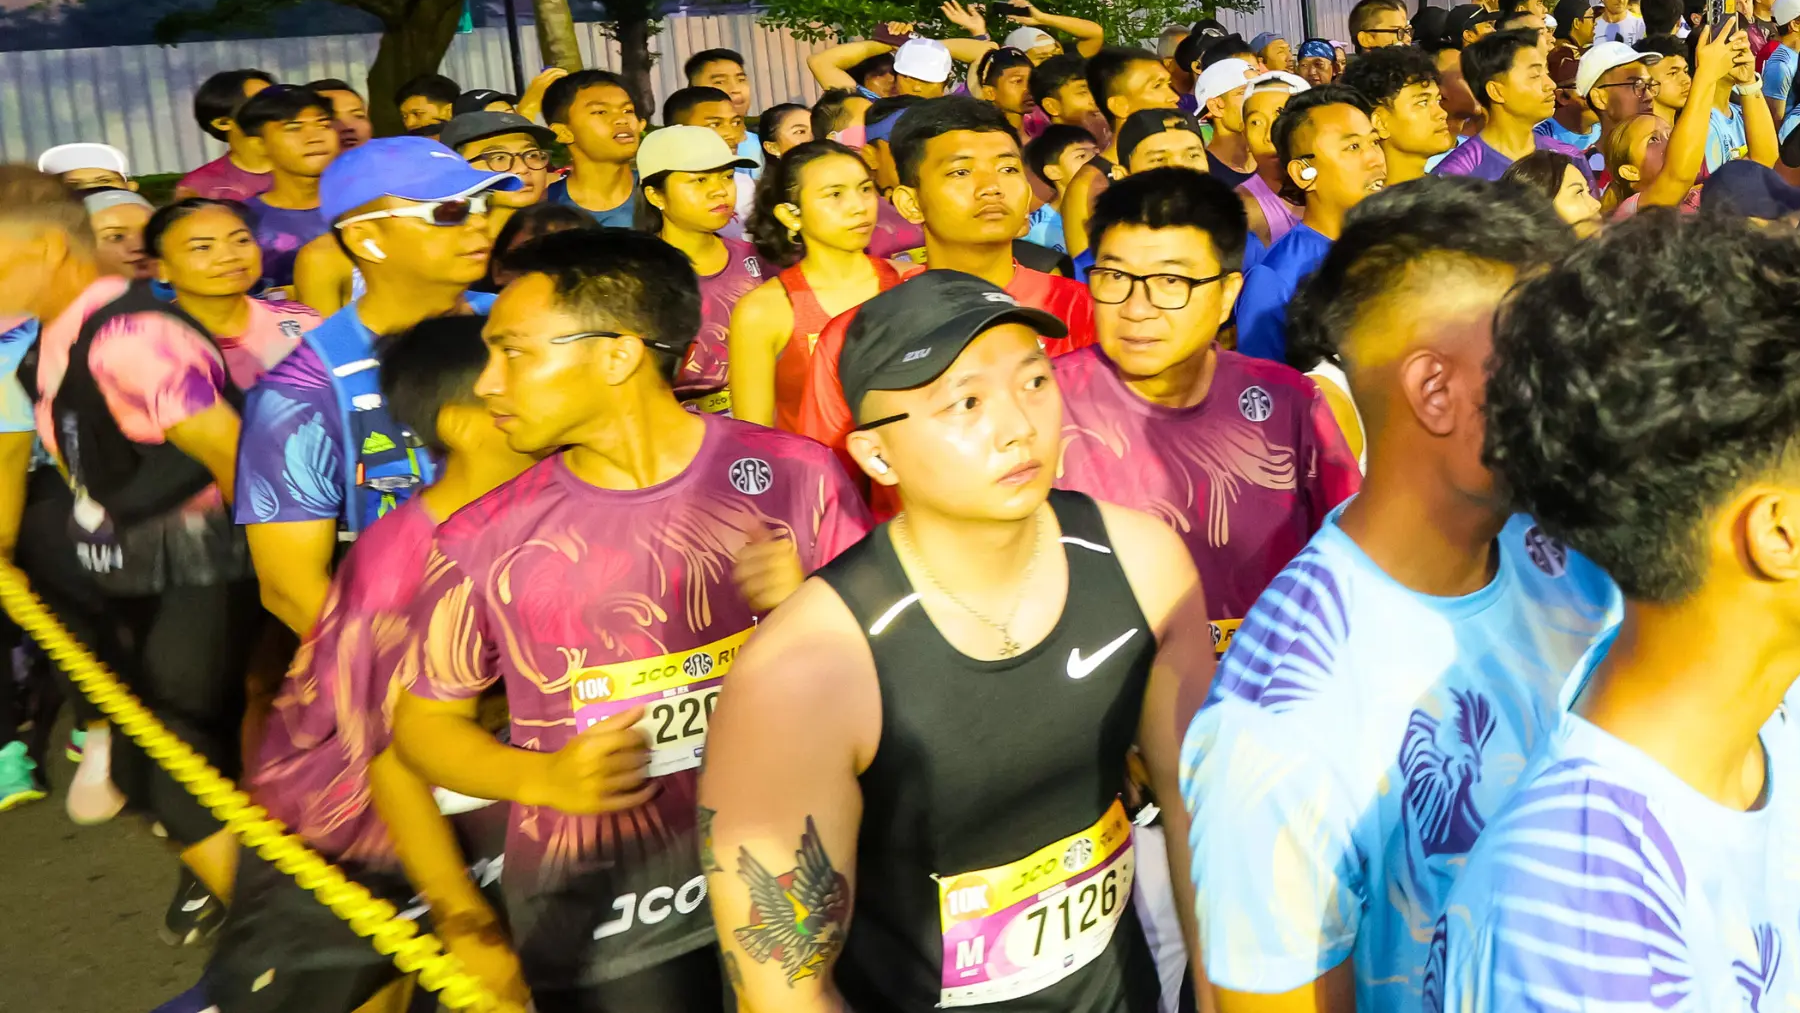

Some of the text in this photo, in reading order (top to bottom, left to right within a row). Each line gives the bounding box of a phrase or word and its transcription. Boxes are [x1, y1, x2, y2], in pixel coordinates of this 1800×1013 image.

[575, 676, 612, 701] 10K
[631, 665, 678, 686] JCO
[1012, 857, 1058, 892] JCO
[593, 874, 708, 941] JCO
[947, 884, 989, 917] 10K
[1027, 869, 1117, 957] 7126
[956, 935, 986, 971] M
